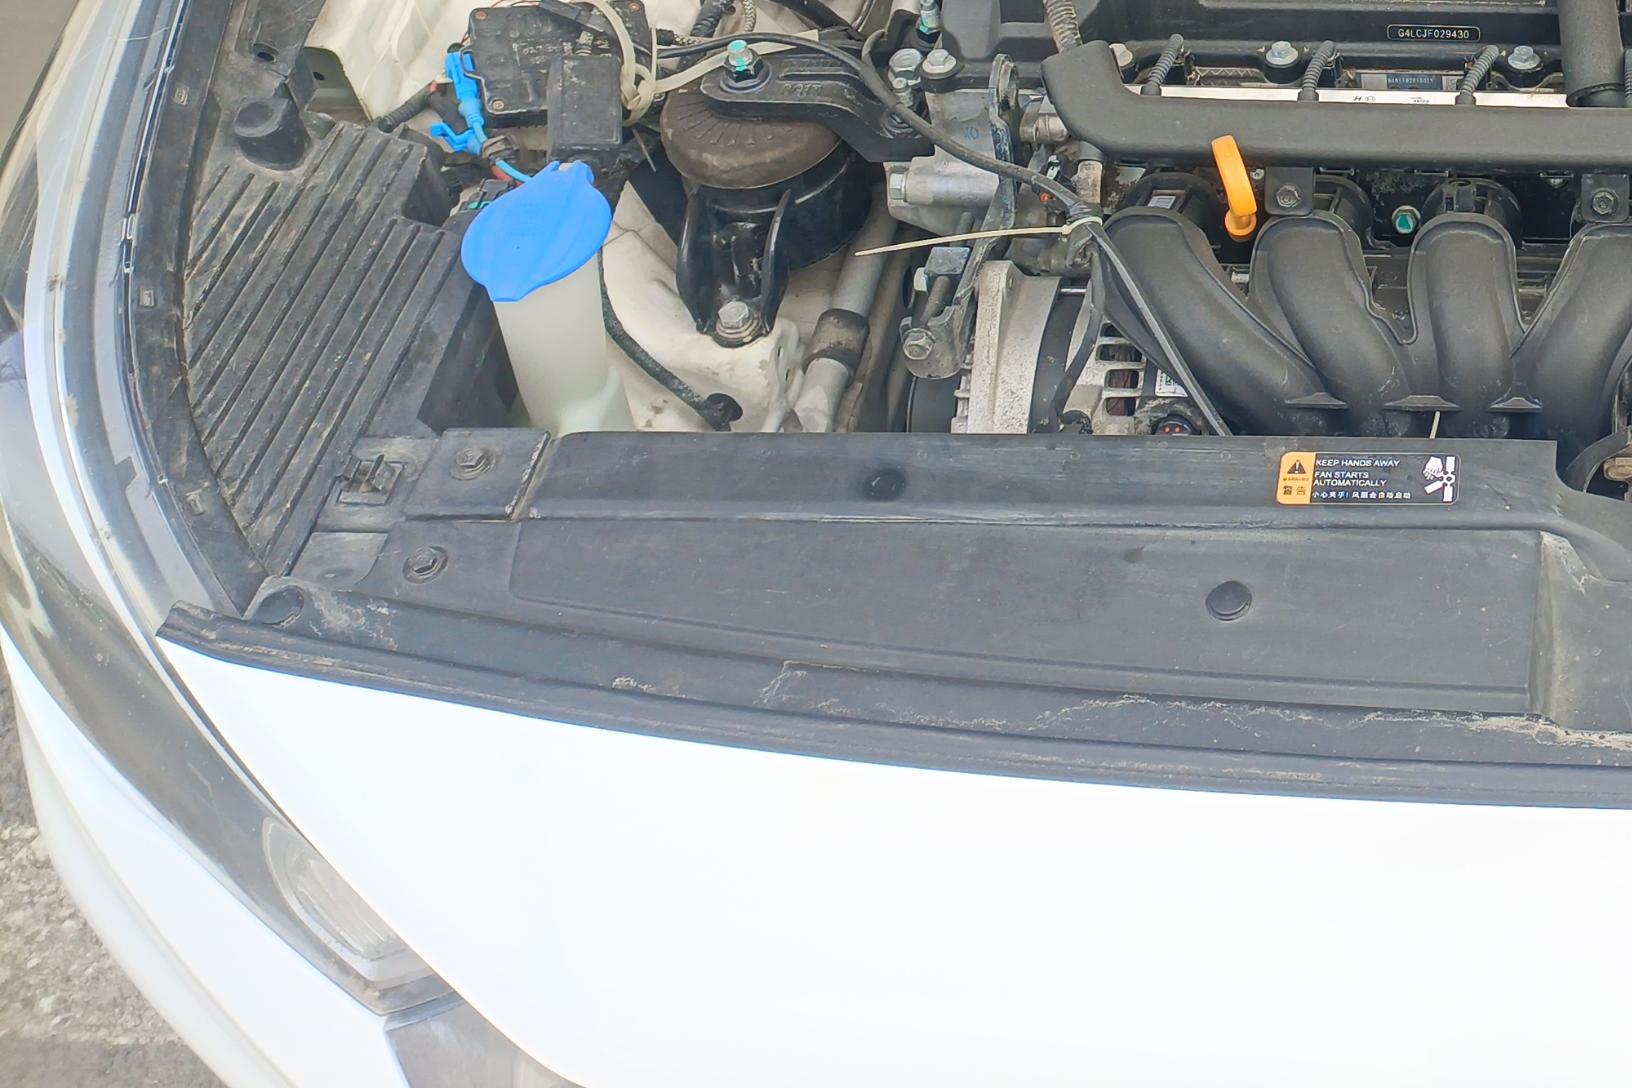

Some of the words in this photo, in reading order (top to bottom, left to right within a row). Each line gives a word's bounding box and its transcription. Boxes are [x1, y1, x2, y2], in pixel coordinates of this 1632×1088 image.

[1398, 28, 1470, 39] G4LCJF029430
[1316, 459, 1339, 467] KEEP
[1314, 471, 1332, 479] FAN
[1333, 471, 1369, 479] STARTS
[1312, 479, 1387, 487] AUTOMATICALLY
